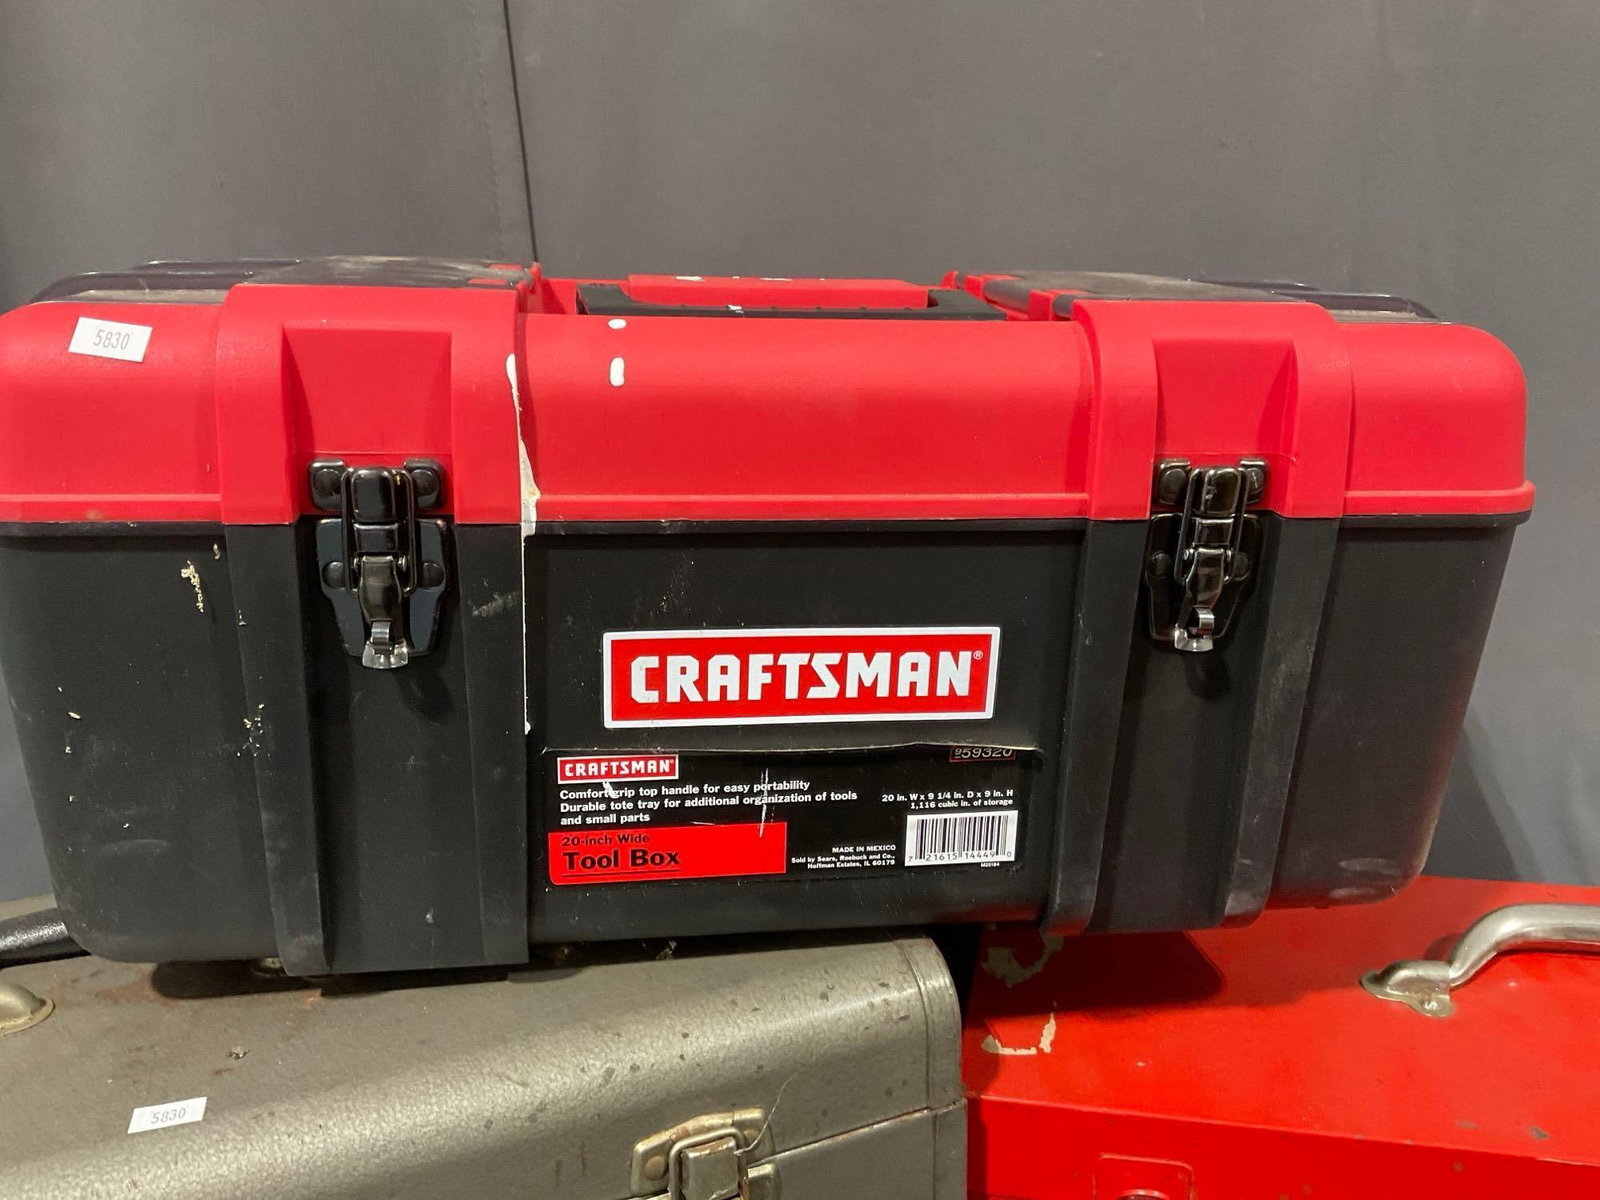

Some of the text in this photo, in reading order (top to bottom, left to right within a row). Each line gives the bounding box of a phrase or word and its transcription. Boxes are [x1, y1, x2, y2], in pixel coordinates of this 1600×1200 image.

[93, 329, 130, 350] 5830
[639, 787, 658, 800] top
[661, 784, 700, 796] handle
[703, 783, 720, 793] for
[724, 784, 750, 795] easy
[753, 780, 810, 792] portability
[881, 794, 895, 802] 20
[897, 793, 907, 801] in.
[910, 793, 919, 801] W
[928, 792, 934, 800] 9
[937, 791, 951, 799] 1/4
[954, 791, 964, 799] in.
[967, 791, 974, 799] D
[993, 789, 1004, 797] in.
[1006, 789, 1013, 797] H
[560, 790, 857, 813] Durable tote tray for additional organization of tools
[910, 801, 936, 810] 1,116
[938, 801, 959, 809] cubic
[984, 799, 1013, 807] storage
[560, 812, 650, 825] and small parts
[562, 833, 650, 846] 20-inch Wide
[832, 846, 854, 854] MADE
[866, 845, 896, 853] MEXICO
[562, 848, 680, 871] Tool Box
[807, 862, 835, 870] Hoffman
[863, 860, 871, 868] IL
[872, 859, 896, 867] 60179
[839, 854, 867, 862] Roebuck
[151, 1107, 186, 1125] 5830
